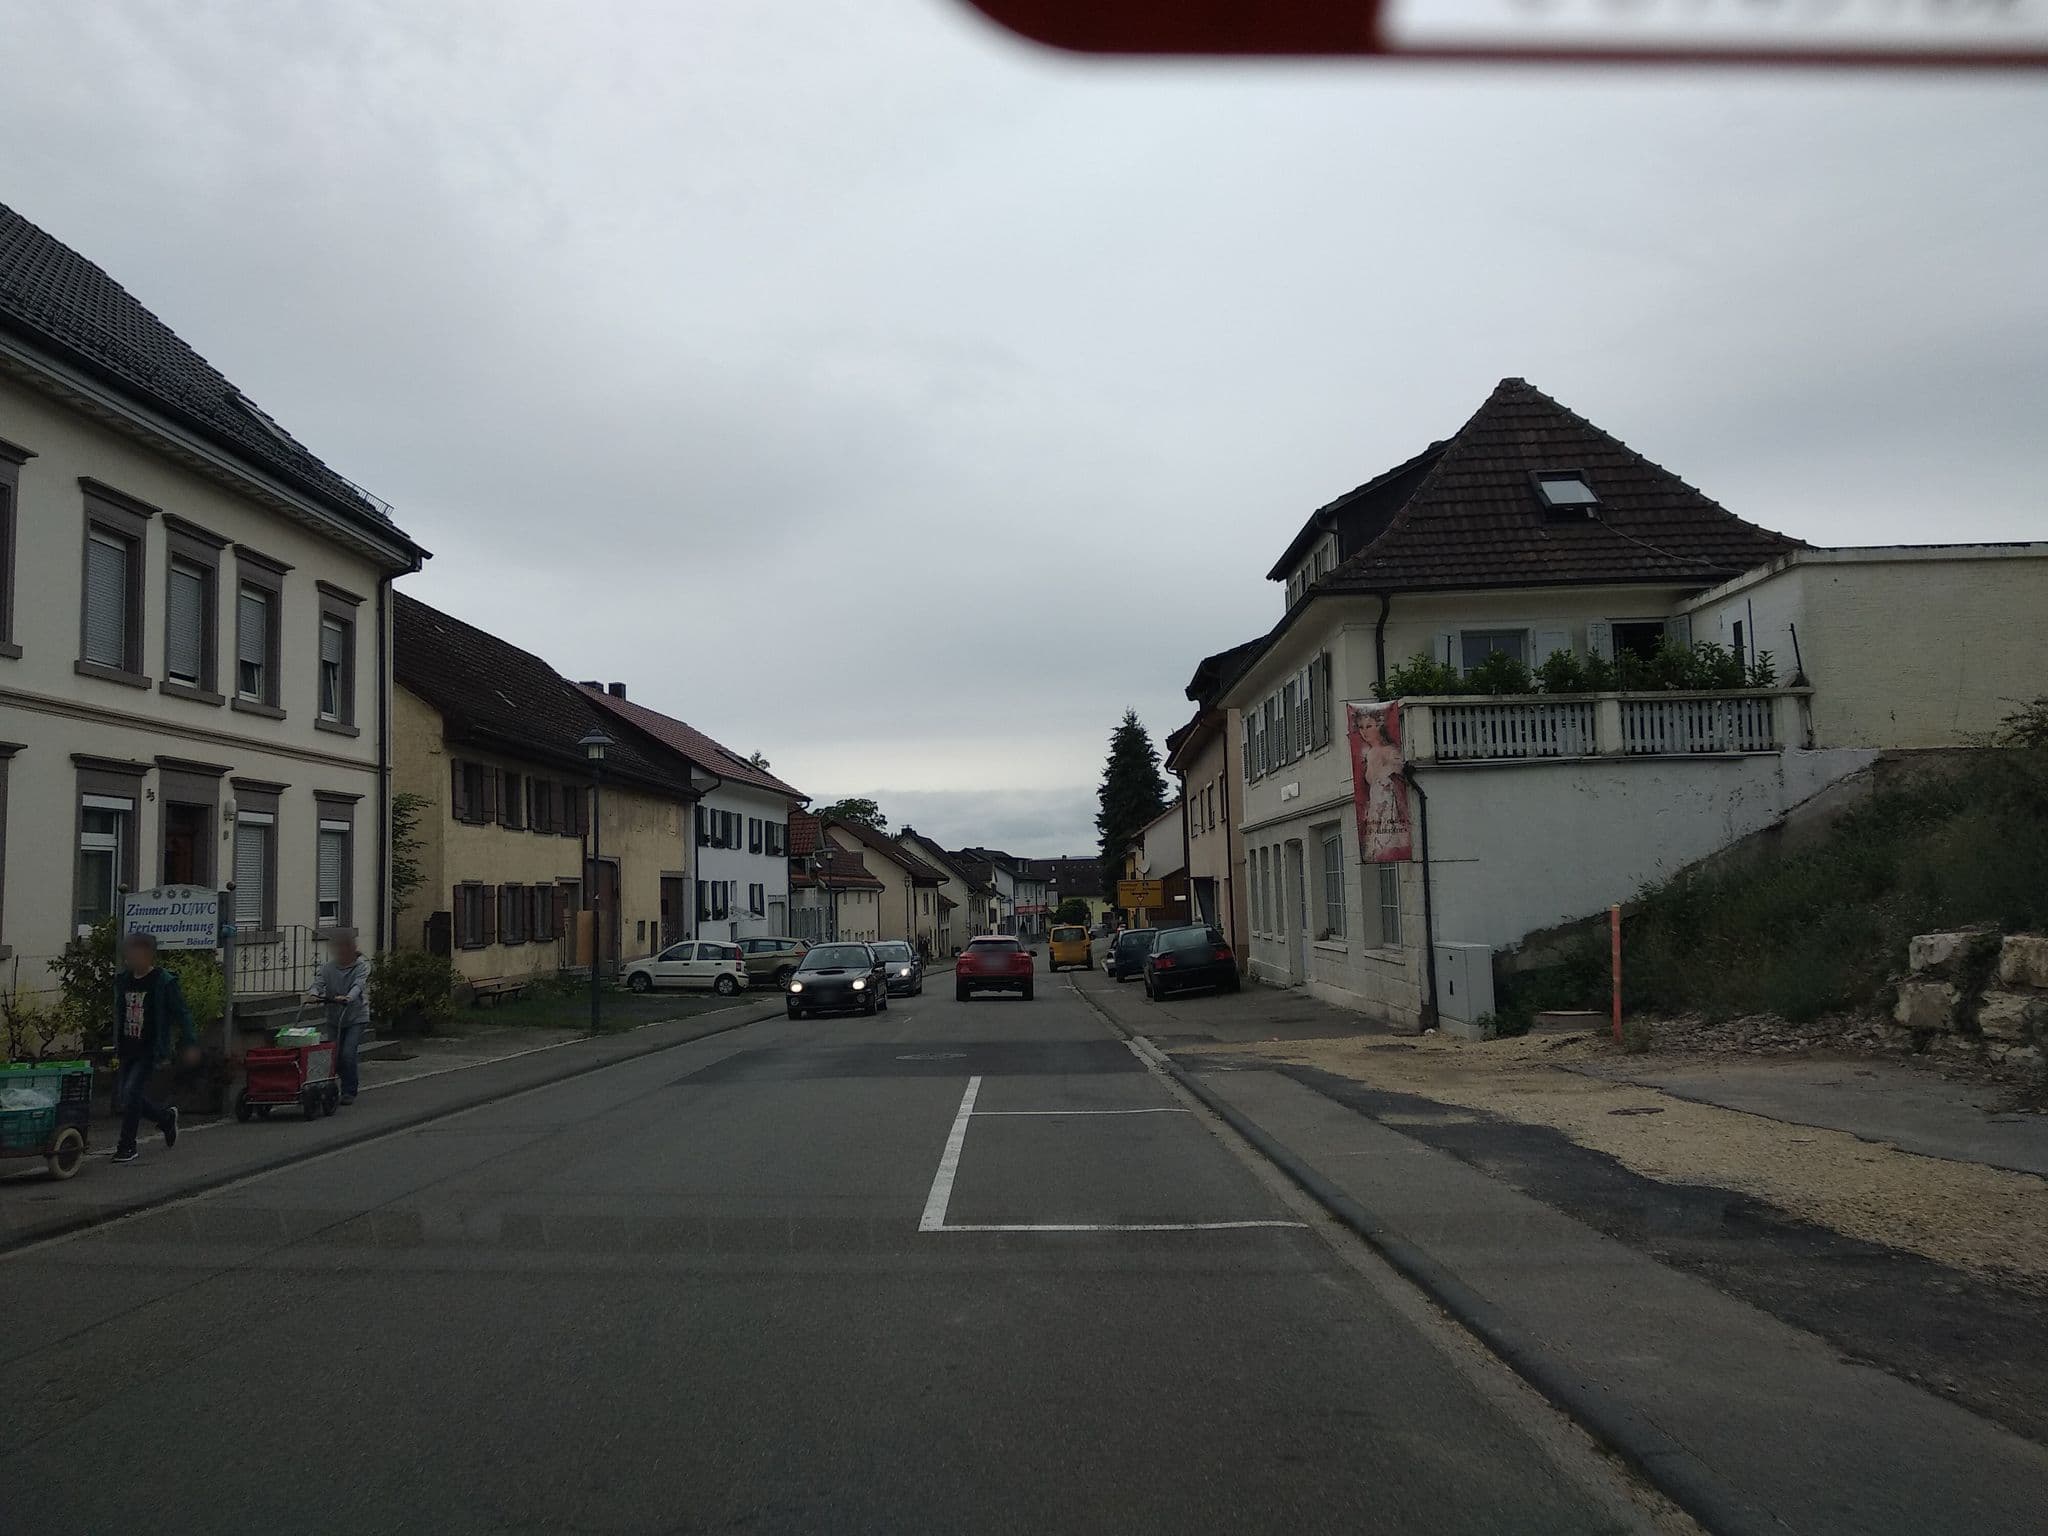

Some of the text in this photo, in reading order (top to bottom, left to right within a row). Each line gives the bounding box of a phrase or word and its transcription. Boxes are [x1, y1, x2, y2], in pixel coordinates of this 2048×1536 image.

[127, 903, 216, 916] Zimmer DU/WC
[129, 921, 214, 935] Ferienwohnung
